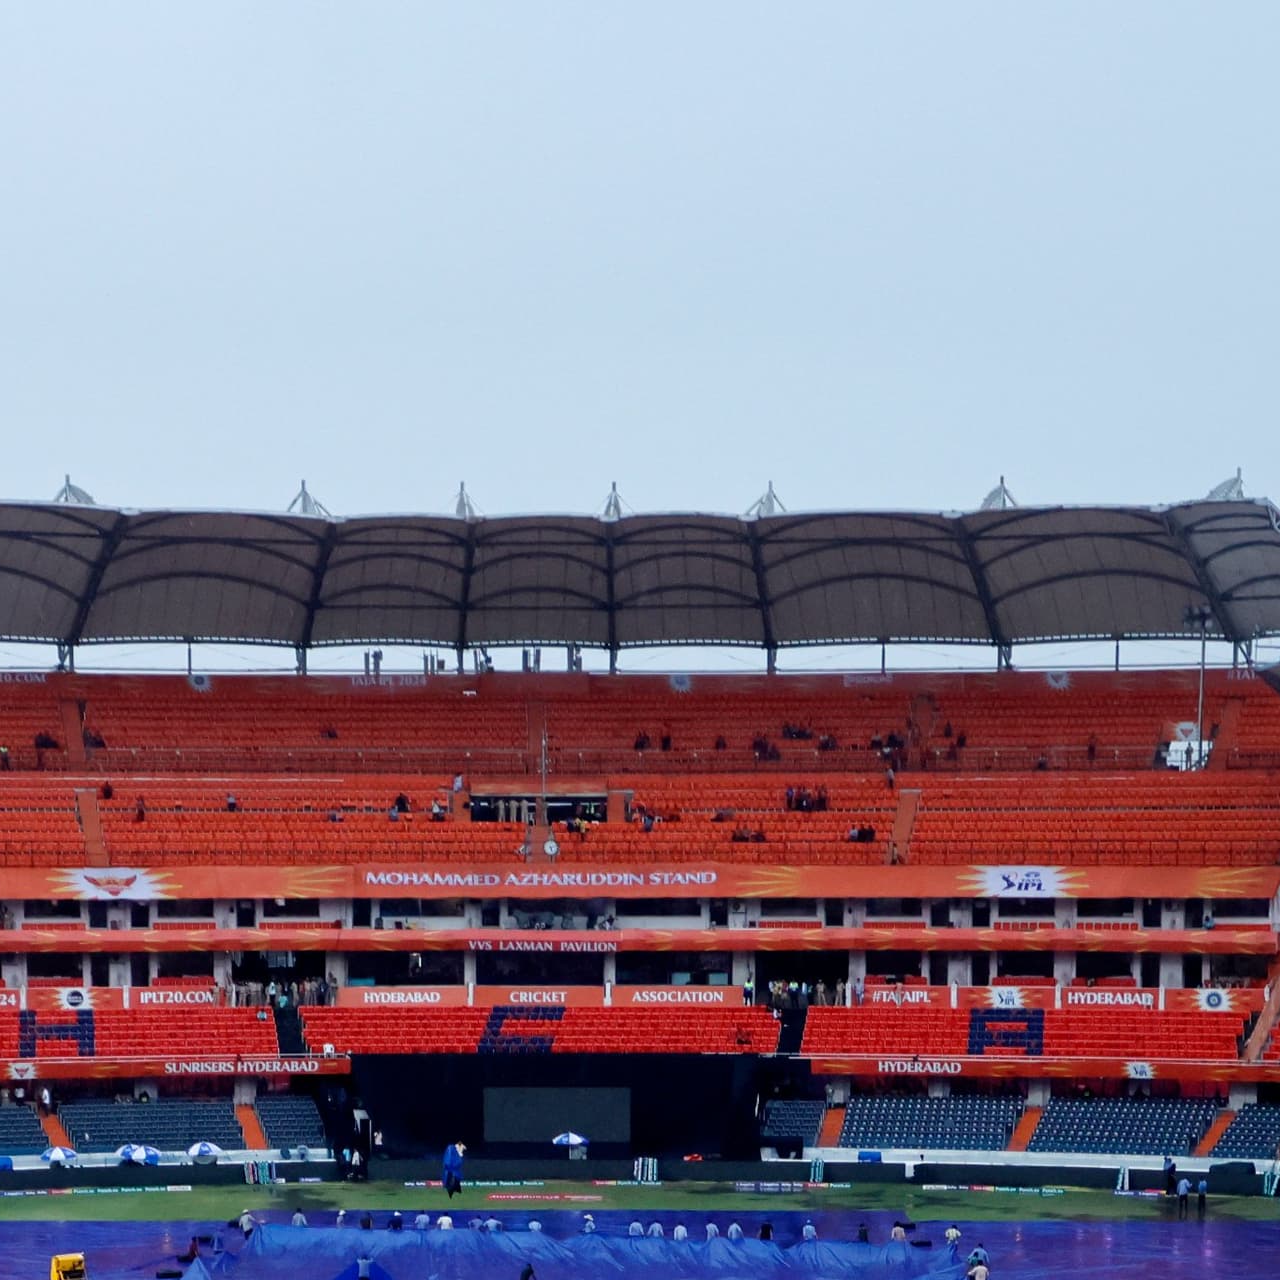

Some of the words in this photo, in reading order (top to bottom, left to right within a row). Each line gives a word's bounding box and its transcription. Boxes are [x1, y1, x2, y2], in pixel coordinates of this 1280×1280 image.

[366, 871, 500, 887] MOHAMMED
[505, 873, 644, 886] AZHARUDDIN
[649, 871, 717, 885] STAND
[1017, 882, 1046, 891] IPL
[469, 941, 492, 951] VVS
[499, 940, 553, 952] LAXMAN
[560, 940, 617, 952] PAVILION
[363, 991, 441, 1003] HYDERABAD
[510, 991, 568, 1003] CRICKET
[632, 991, 724, 1003] ASSOCIATION
[872, 990, 931, 1004] #TAAIPL
[165, 1062, 235, 1074] SUNRISERS
[237, 1061, 320, 1073] HYDERABAD
[877, 1060, 963, 1074] HYDERABAD
